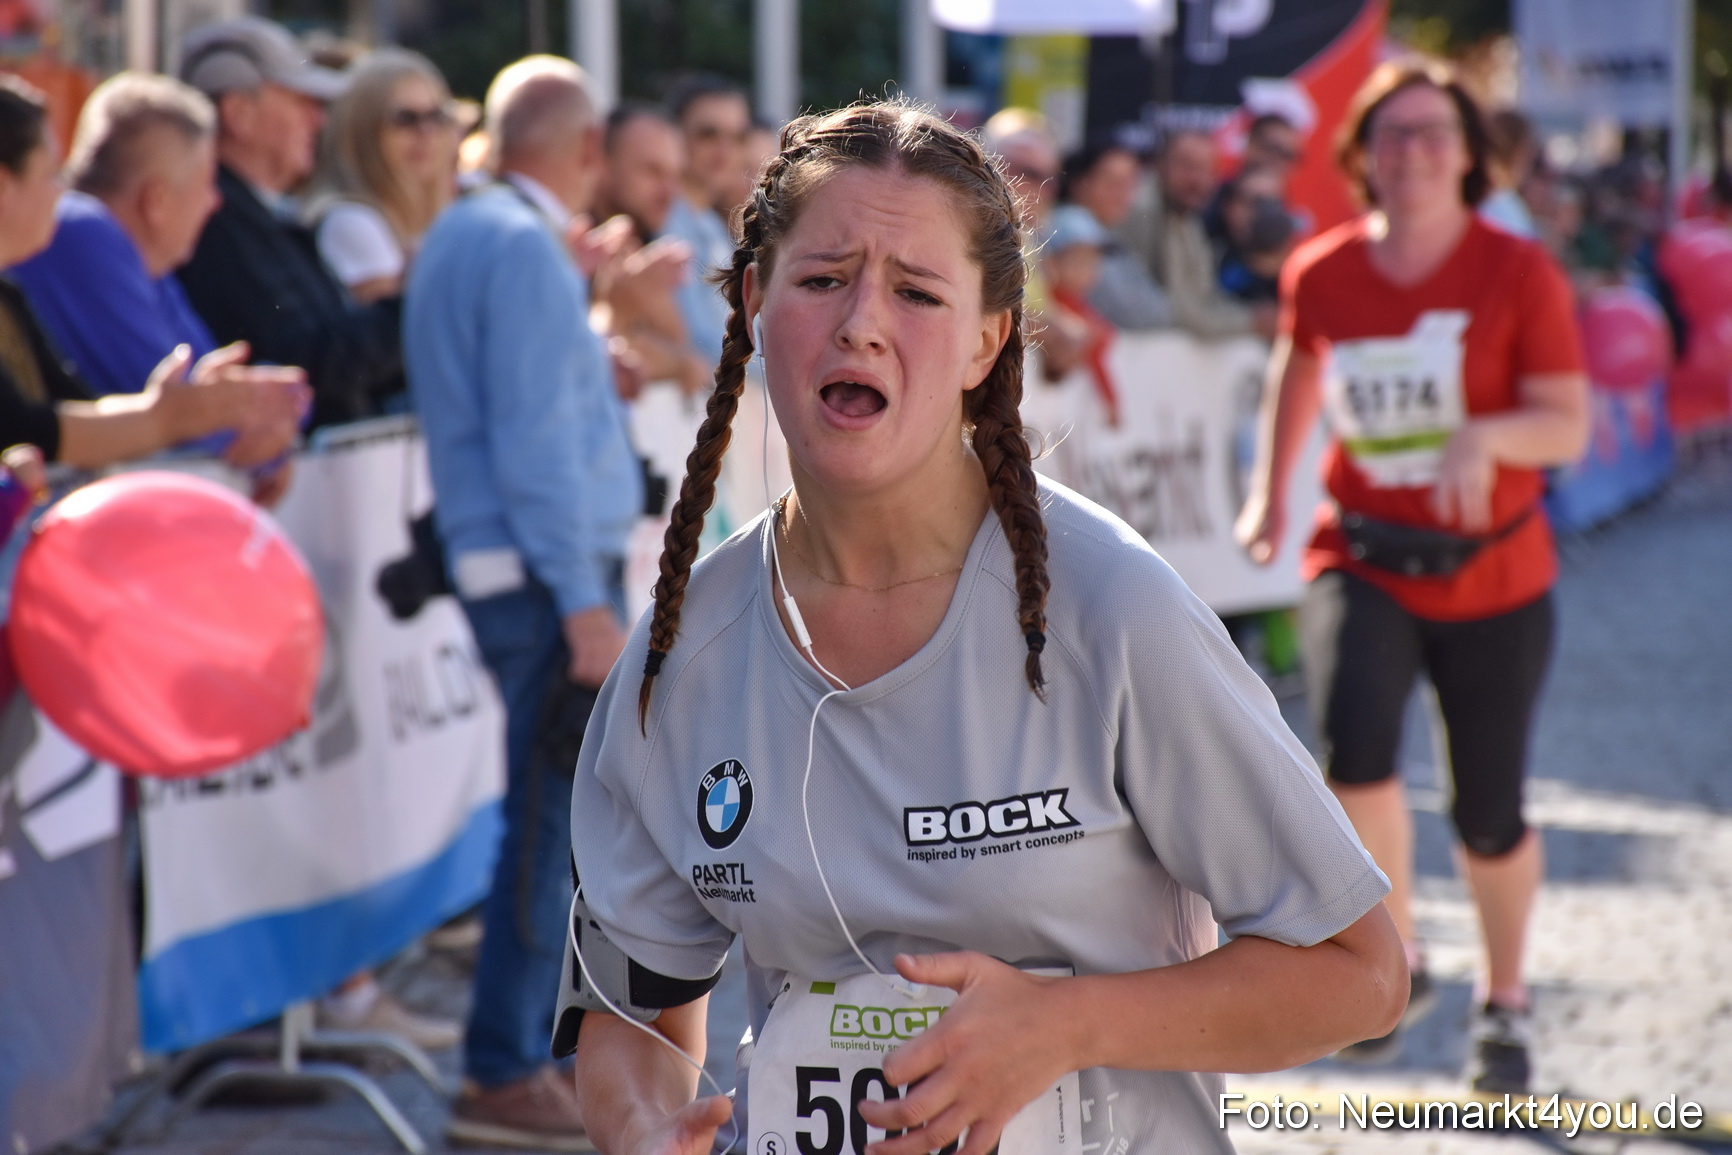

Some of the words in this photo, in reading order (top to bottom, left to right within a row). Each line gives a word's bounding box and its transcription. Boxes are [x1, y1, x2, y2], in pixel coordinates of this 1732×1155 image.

[702, 761, 749, 791] BMW
[904, 788, 1081, 846] BOCK
[907, 848, 957, 863] inspired
[961, 846, 976, 861] by
[981, 840, 1021, 856] smart
[1025, 829, 1085, 850] concepts
[692, 863, 753, 886] PARTL
[698, 886, 757, 903] Neumarkt
[830, 1039, 870, 1052] inspired
[873, 1041, 885, 1053] by
